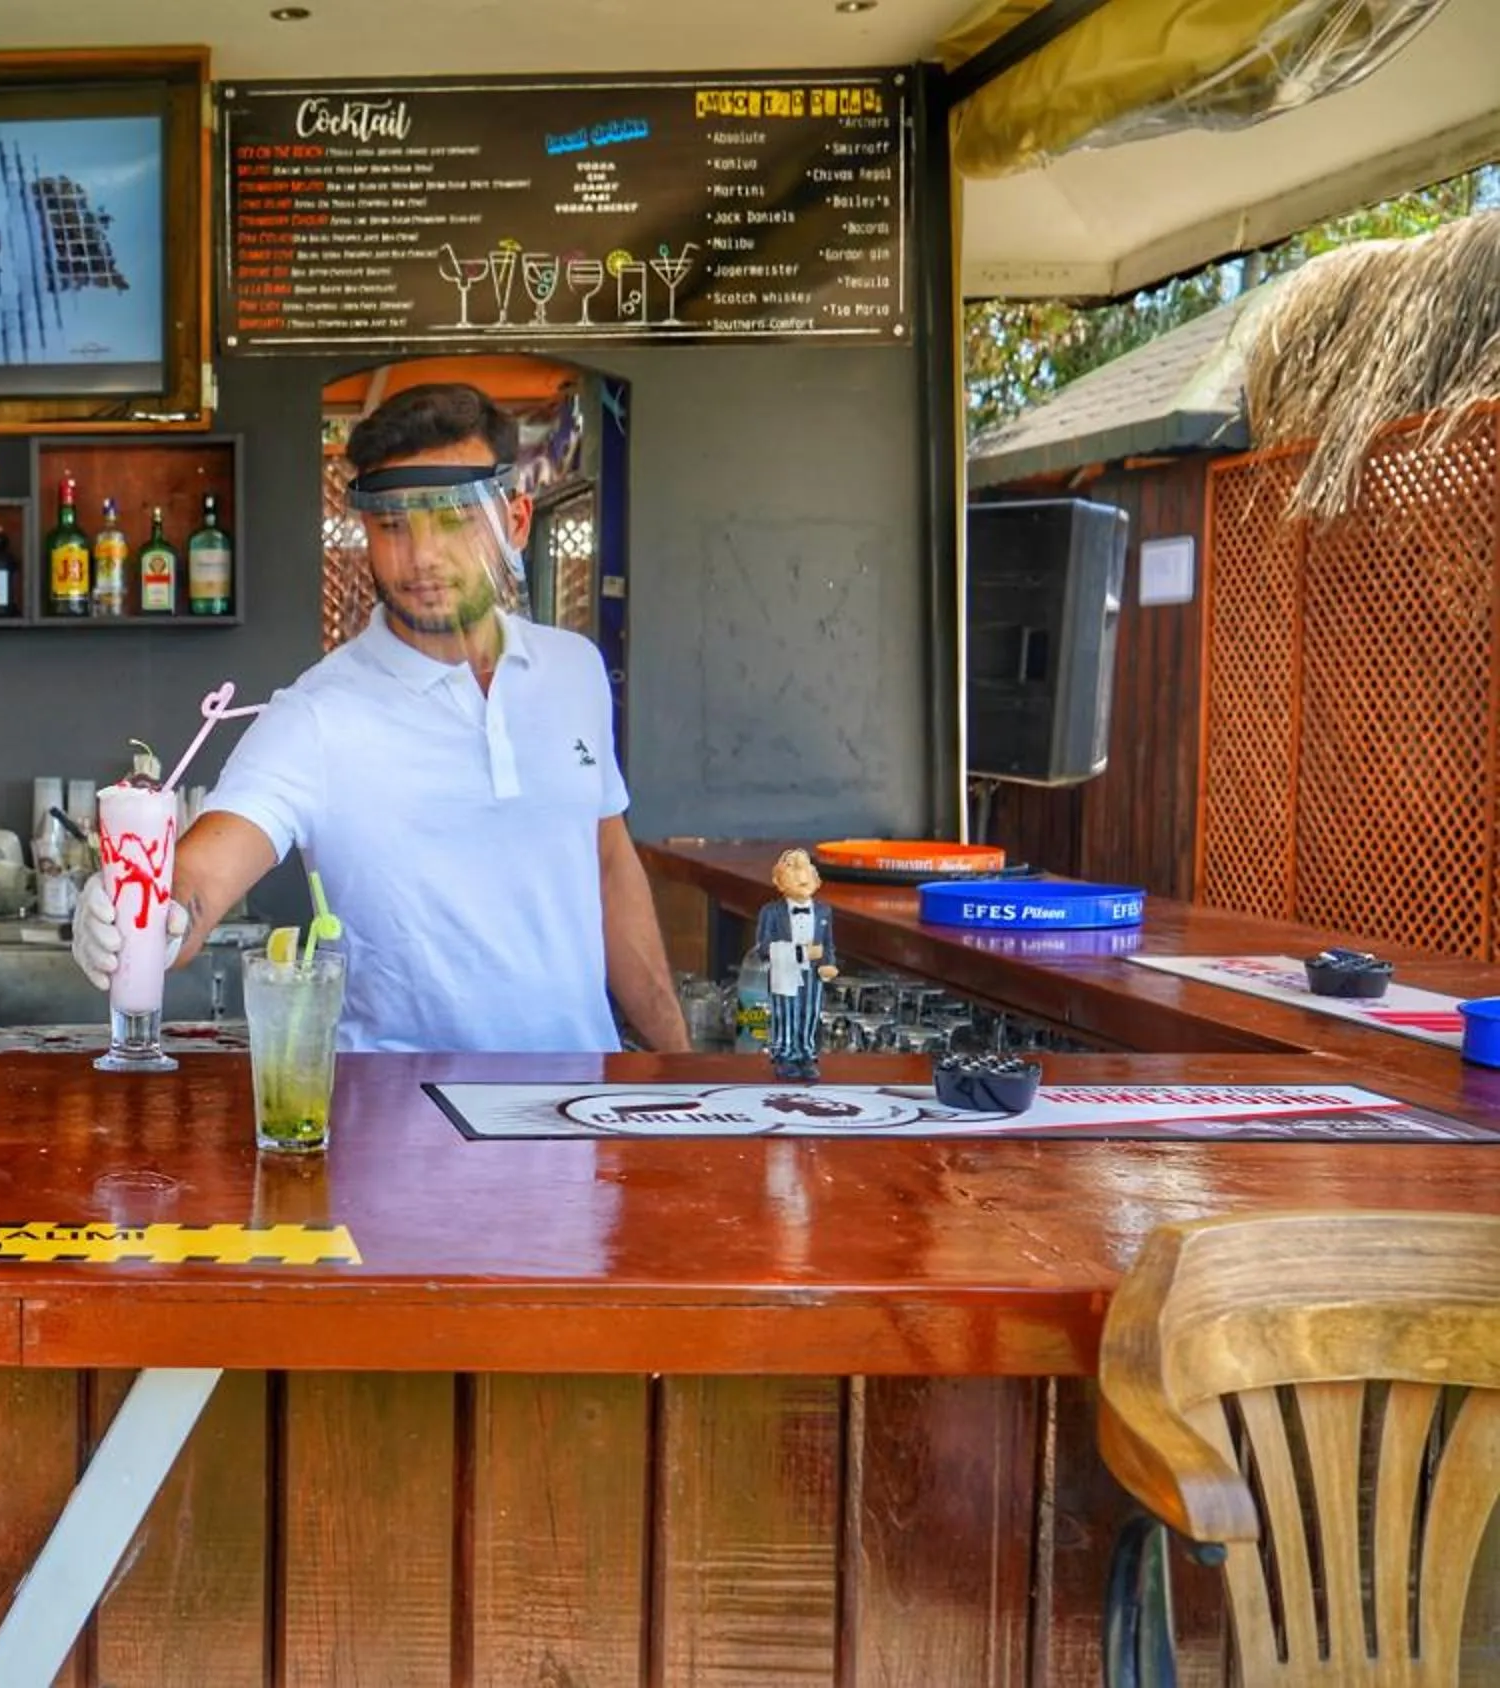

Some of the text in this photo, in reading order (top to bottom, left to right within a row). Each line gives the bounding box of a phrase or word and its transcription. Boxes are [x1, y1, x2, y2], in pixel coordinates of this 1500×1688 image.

[296, 98, 411, 142] Cocktail
[713, 184, 765, 197] Martini
[713, 212, 741, 225] Jack
[713, 292, 757, 304] Scotch
[963, 903, 1067, 920] EFES Pilsen
[591, 1113, 754, 1124] CARLING
